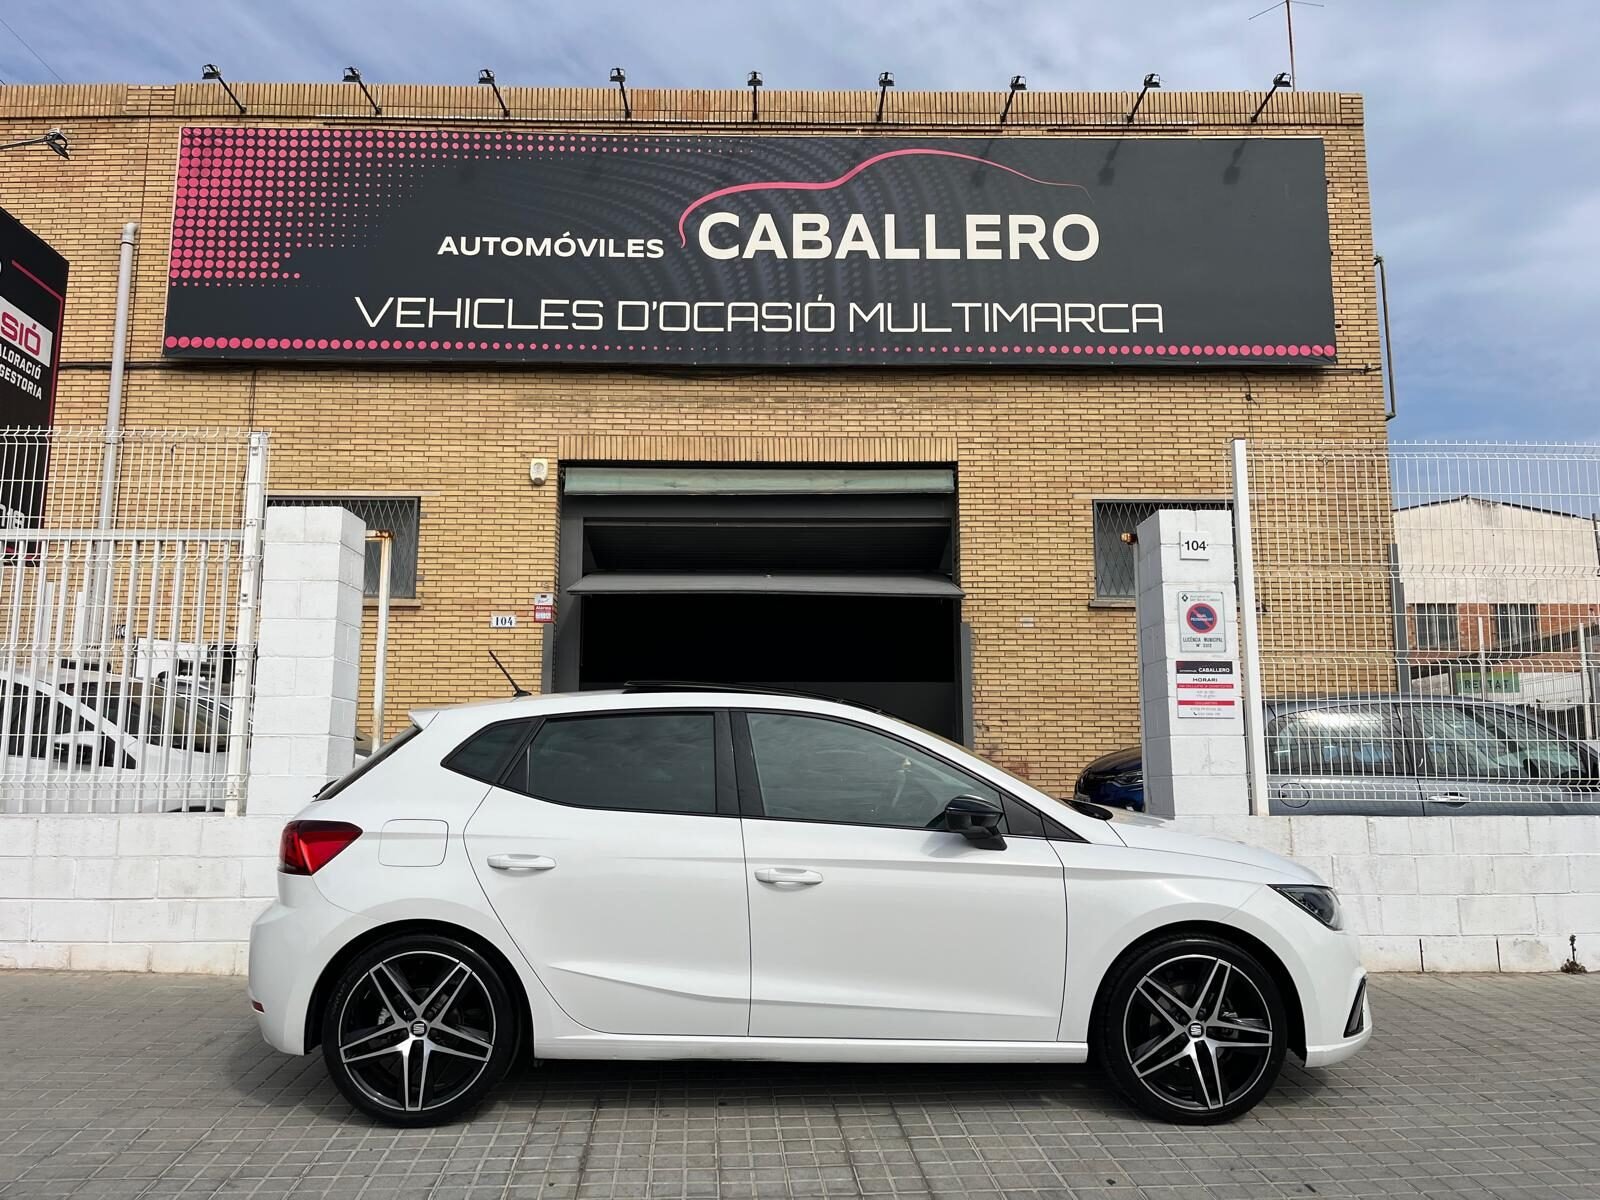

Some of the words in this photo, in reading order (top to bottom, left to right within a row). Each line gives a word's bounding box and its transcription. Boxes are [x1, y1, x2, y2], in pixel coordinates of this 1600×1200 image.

[437, 231, 664, 259] AUTOMÓVILES
[698, 211, 1100, 262] CABALLERO
[354, 296, 604, 331] VEHICLES
[617, 293, 835, 333] D'OCASIÓ
[849, 302, 1164, 334] MULTIMARCA
[0, 343, 41, 380] LORACIÓ
[0, 363, 42, 401] GESTORIA
[1184, 540, 1207, 551] 104
[495, 616, 513, 626] 104
[1464, 679, 1509, 689] RETAT
